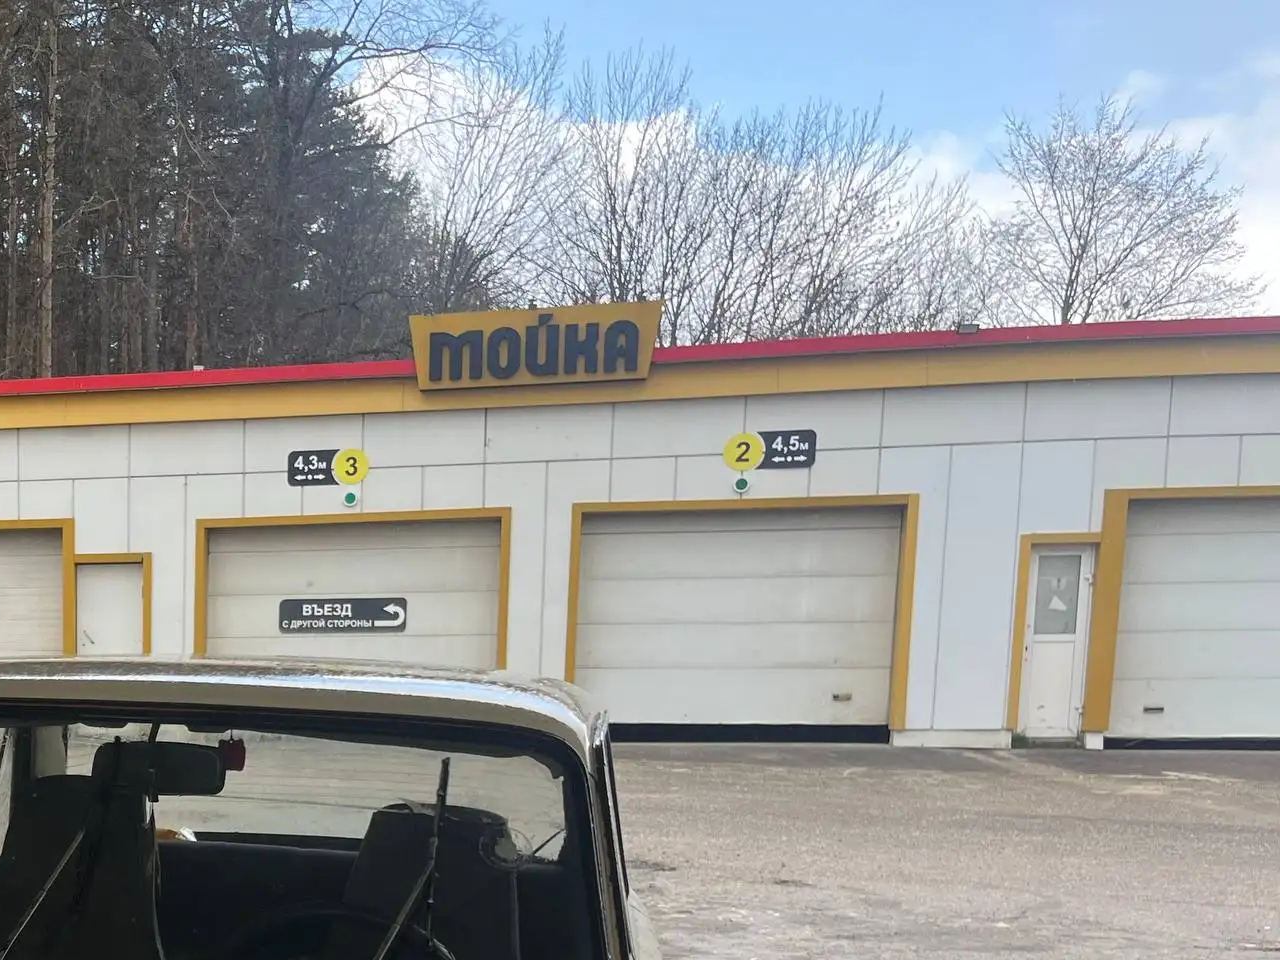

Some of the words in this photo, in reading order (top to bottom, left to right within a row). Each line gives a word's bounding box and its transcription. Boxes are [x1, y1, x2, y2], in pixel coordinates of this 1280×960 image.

[429, 313, 640, 382] МОЙКА
[735, 441, 751, 463] 2
[344, 456, 358, 476] 3
[302, 603, 352, 617] ВЪЕЗД
[289, 618, 326, 629] ДРУГОЙ
[327, 619, 372, 628] СТОРОНЫ
